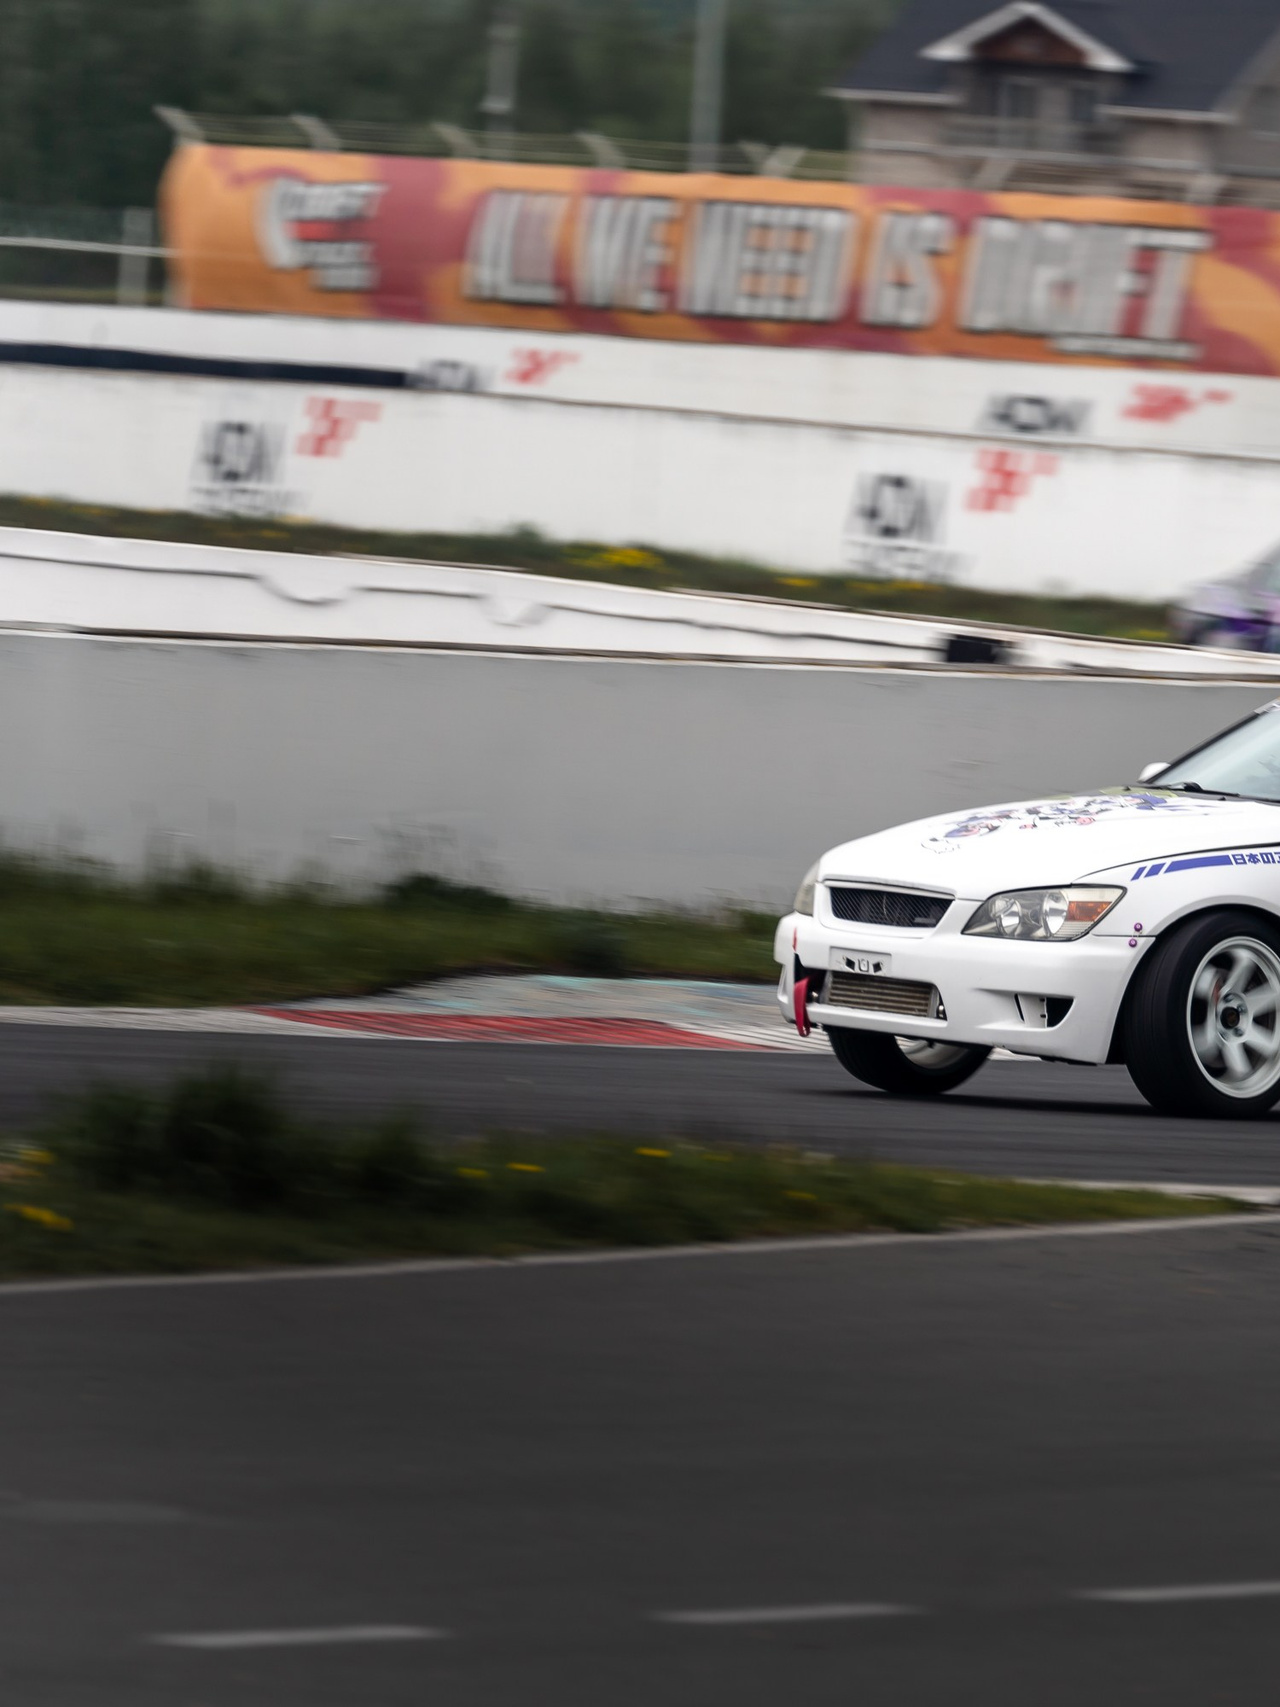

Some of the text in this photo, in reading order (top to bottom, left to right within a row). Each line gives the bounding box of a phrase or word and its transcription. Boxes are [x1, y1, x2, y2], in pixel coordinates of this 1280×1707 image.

[574, 194, 684, 316] WE
[680, 200, 856, 323] NEED
[858, 212, 955, 331] IS
